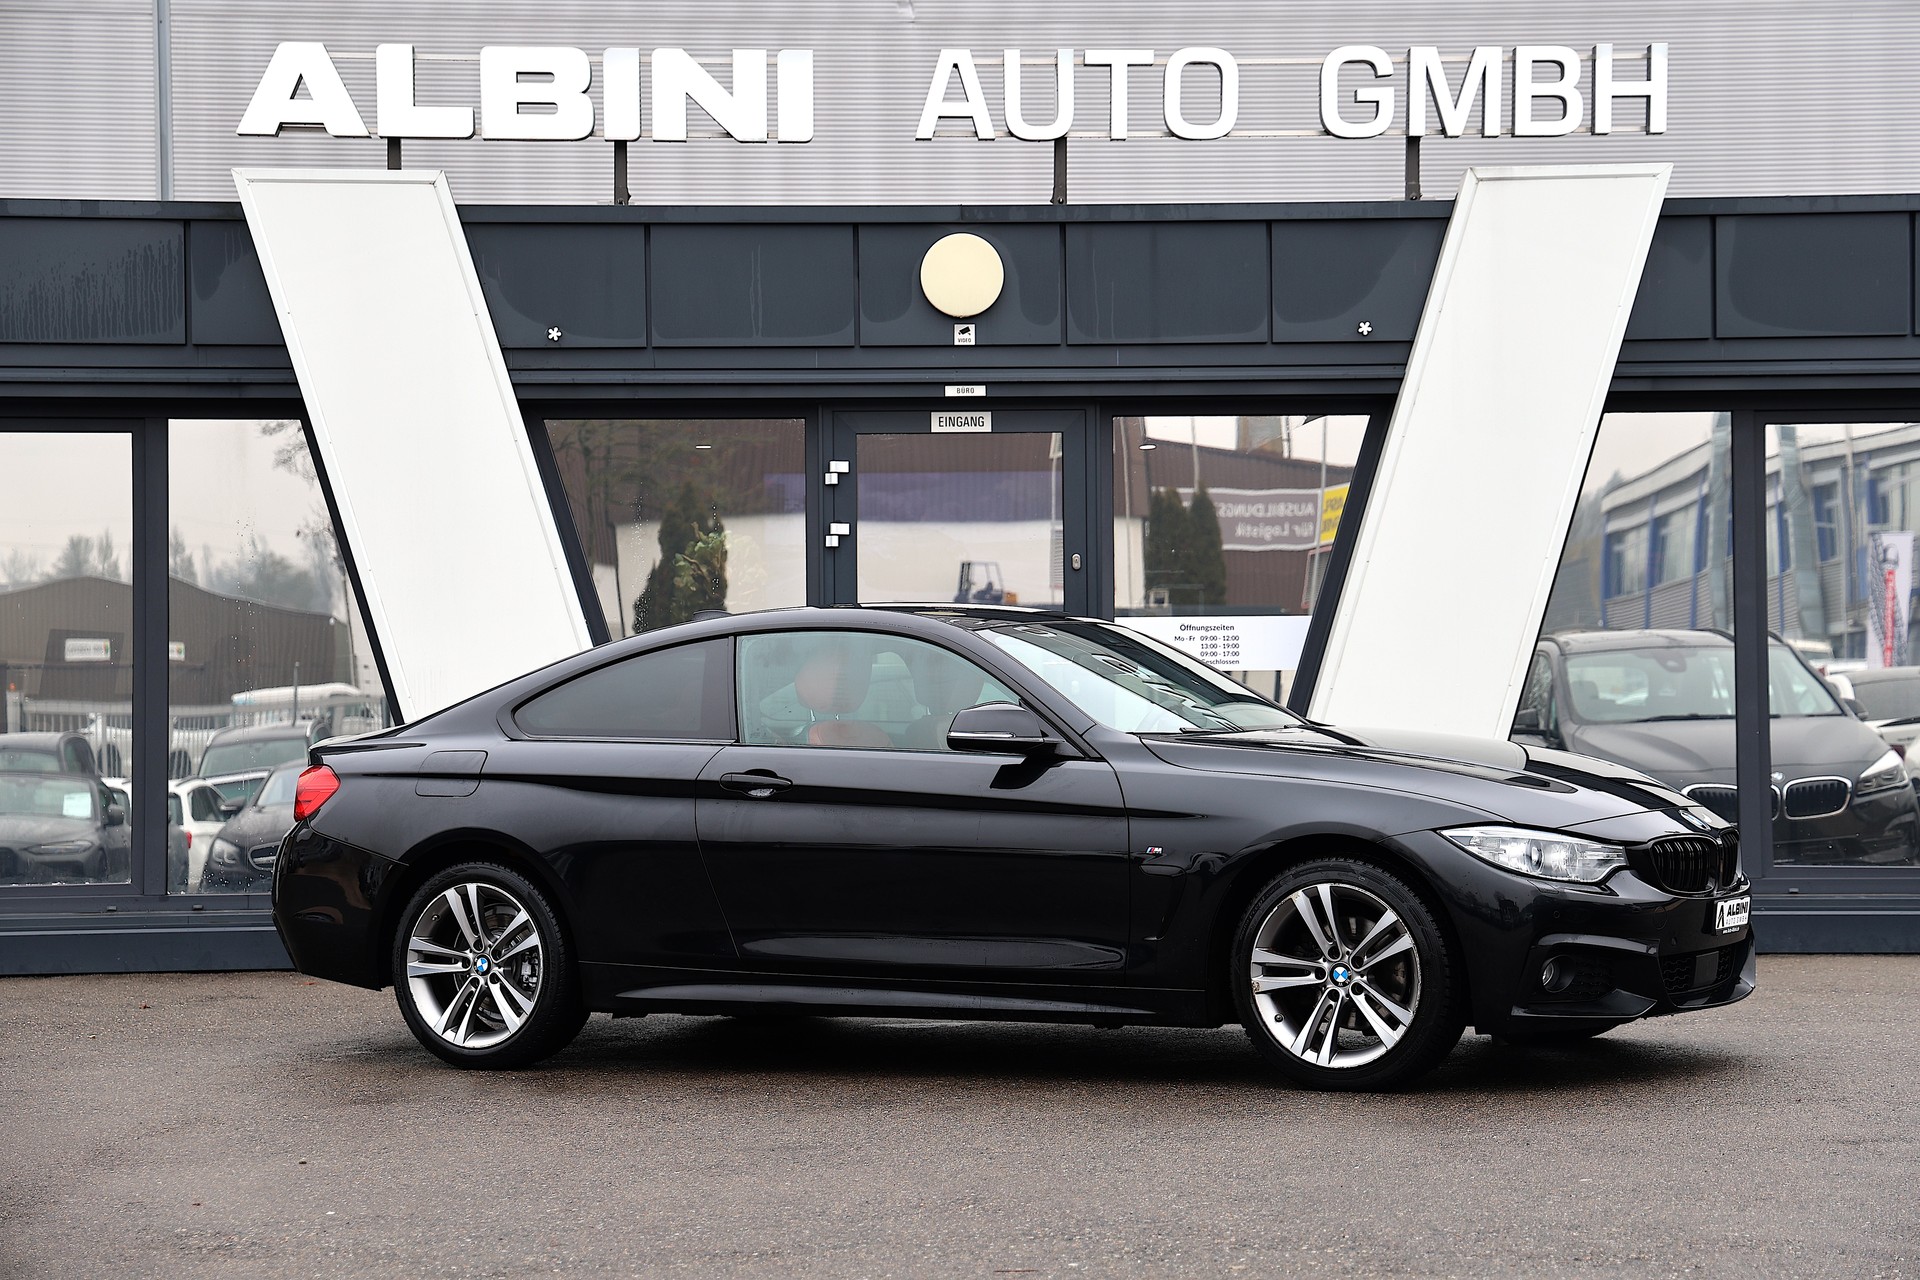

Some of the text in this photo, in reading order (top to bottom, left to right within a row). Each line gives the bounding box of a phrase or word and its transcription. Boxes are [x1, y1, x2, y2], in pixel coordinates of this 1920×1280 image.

[237, 42, 1669, 143] ALBINI AUTO GMBH
[956, 386, 975, 394] BÜRO
[938, 415, 985, 428] EINGANG
[1179, 623, 1235, 632] Öffnungszeiten
[1727, 901, 1748, 917] ALBINI
